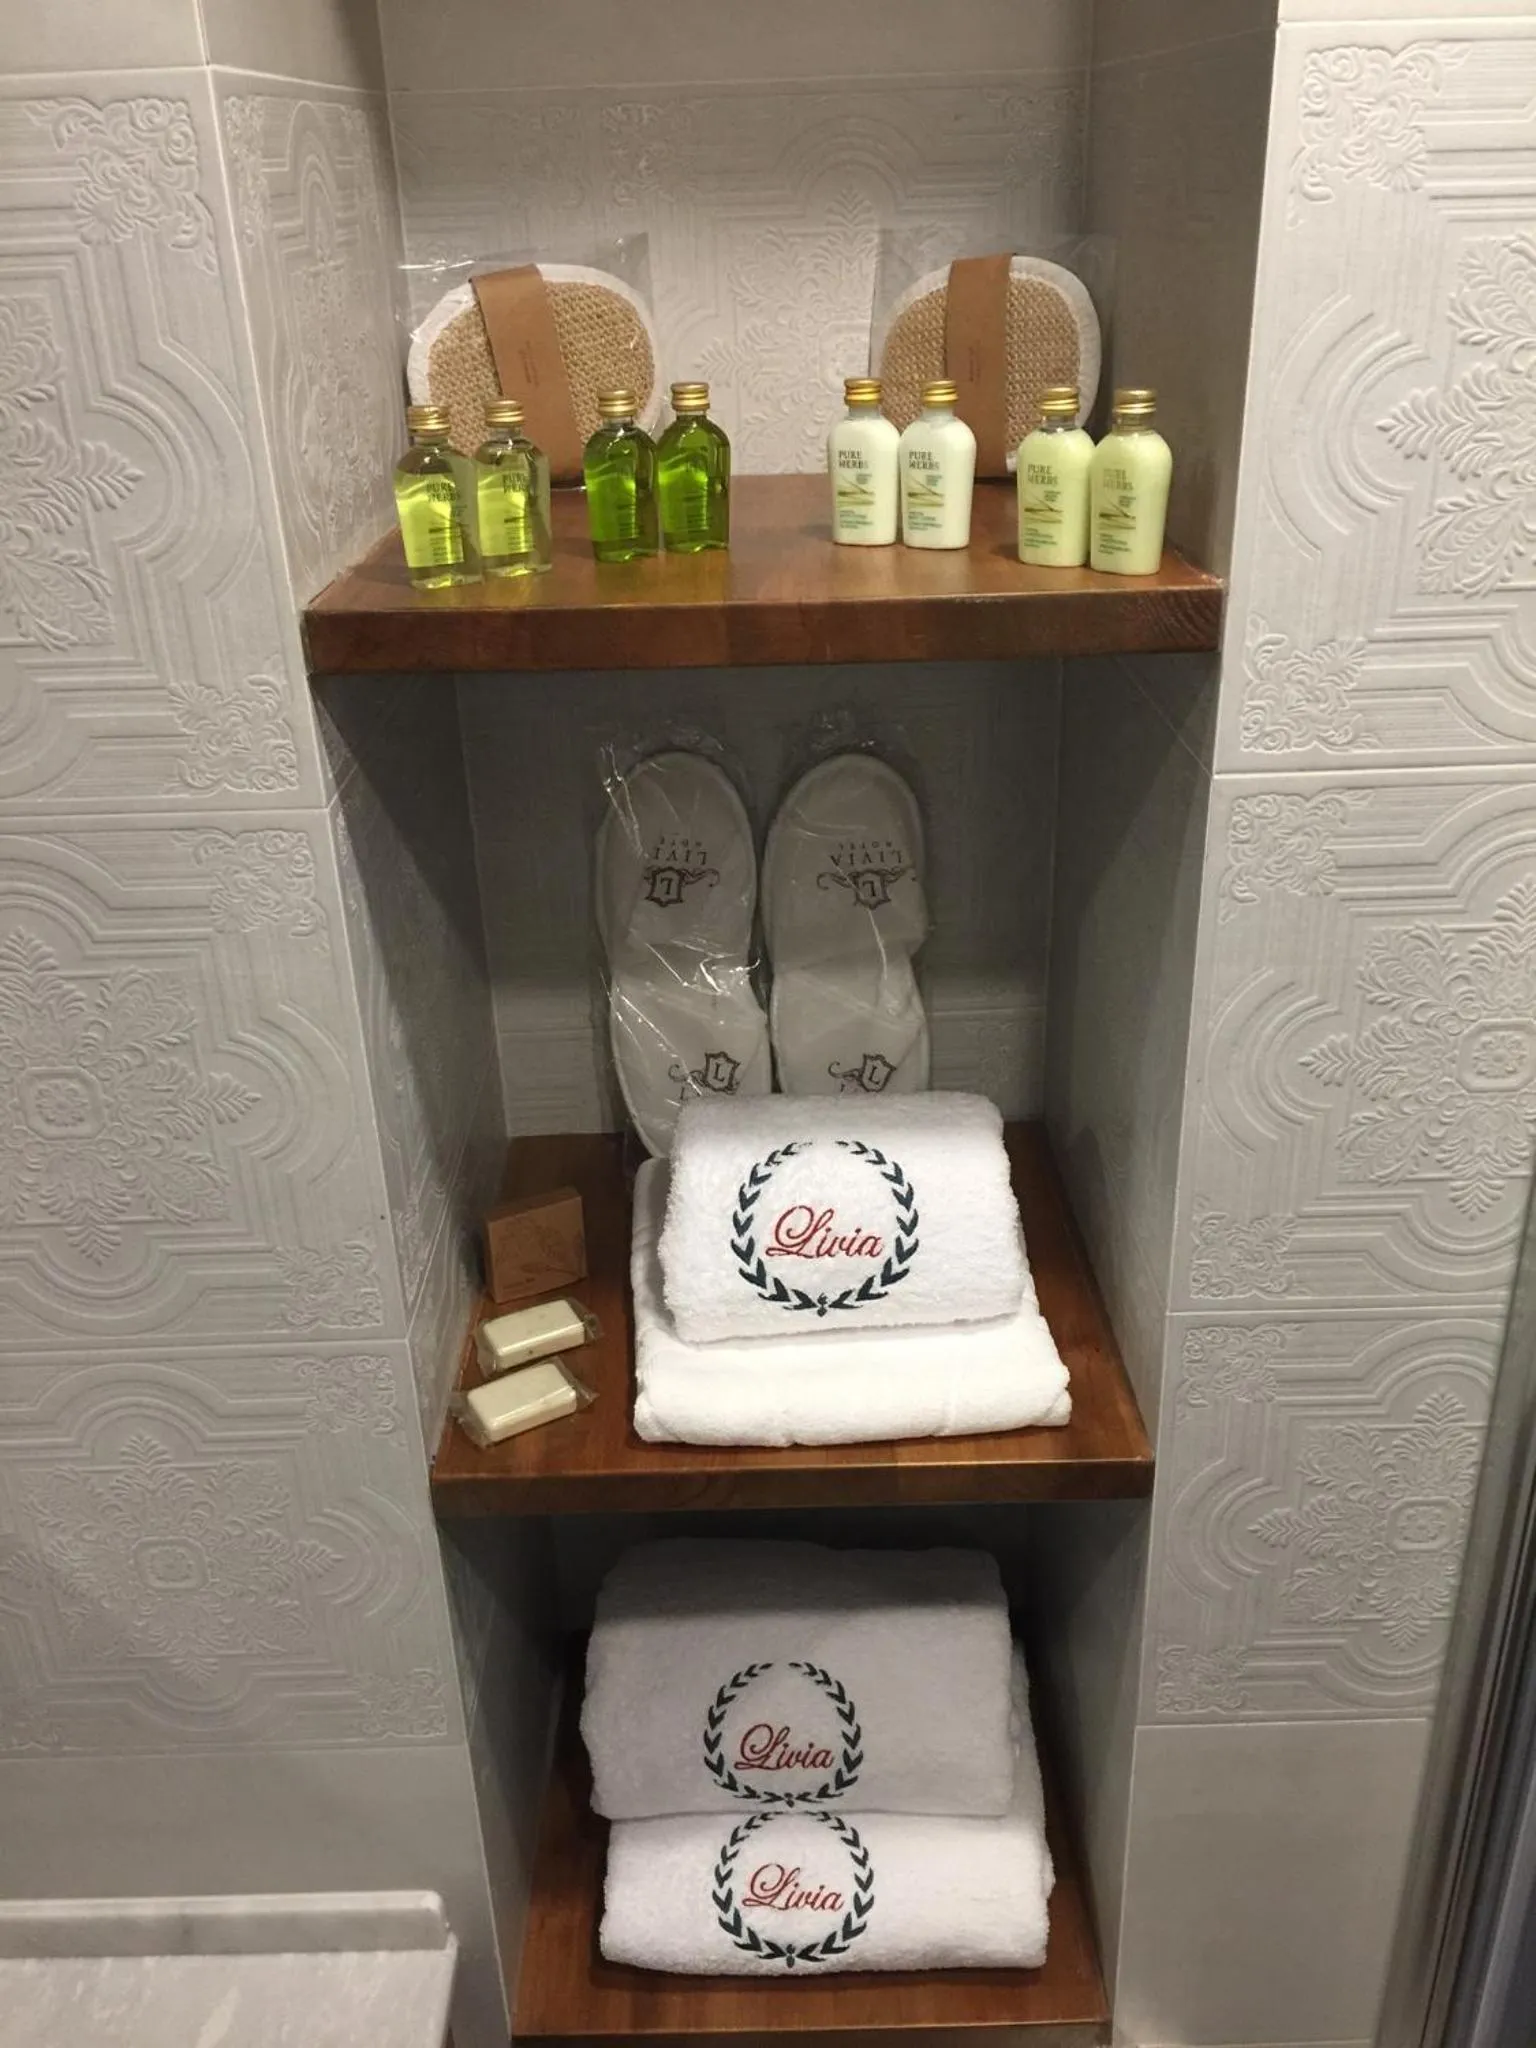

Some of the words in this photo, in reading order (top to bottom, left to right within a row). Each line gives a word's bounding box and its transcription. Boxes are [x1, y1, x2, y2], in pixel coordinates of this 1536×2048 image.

[829, 850, 903, 866] LIVIA
[765, 1204, 885, 1260] Livia
[733, 1722, 836, 1772] Livia
[741, 1862, 845, 1912] Livia
